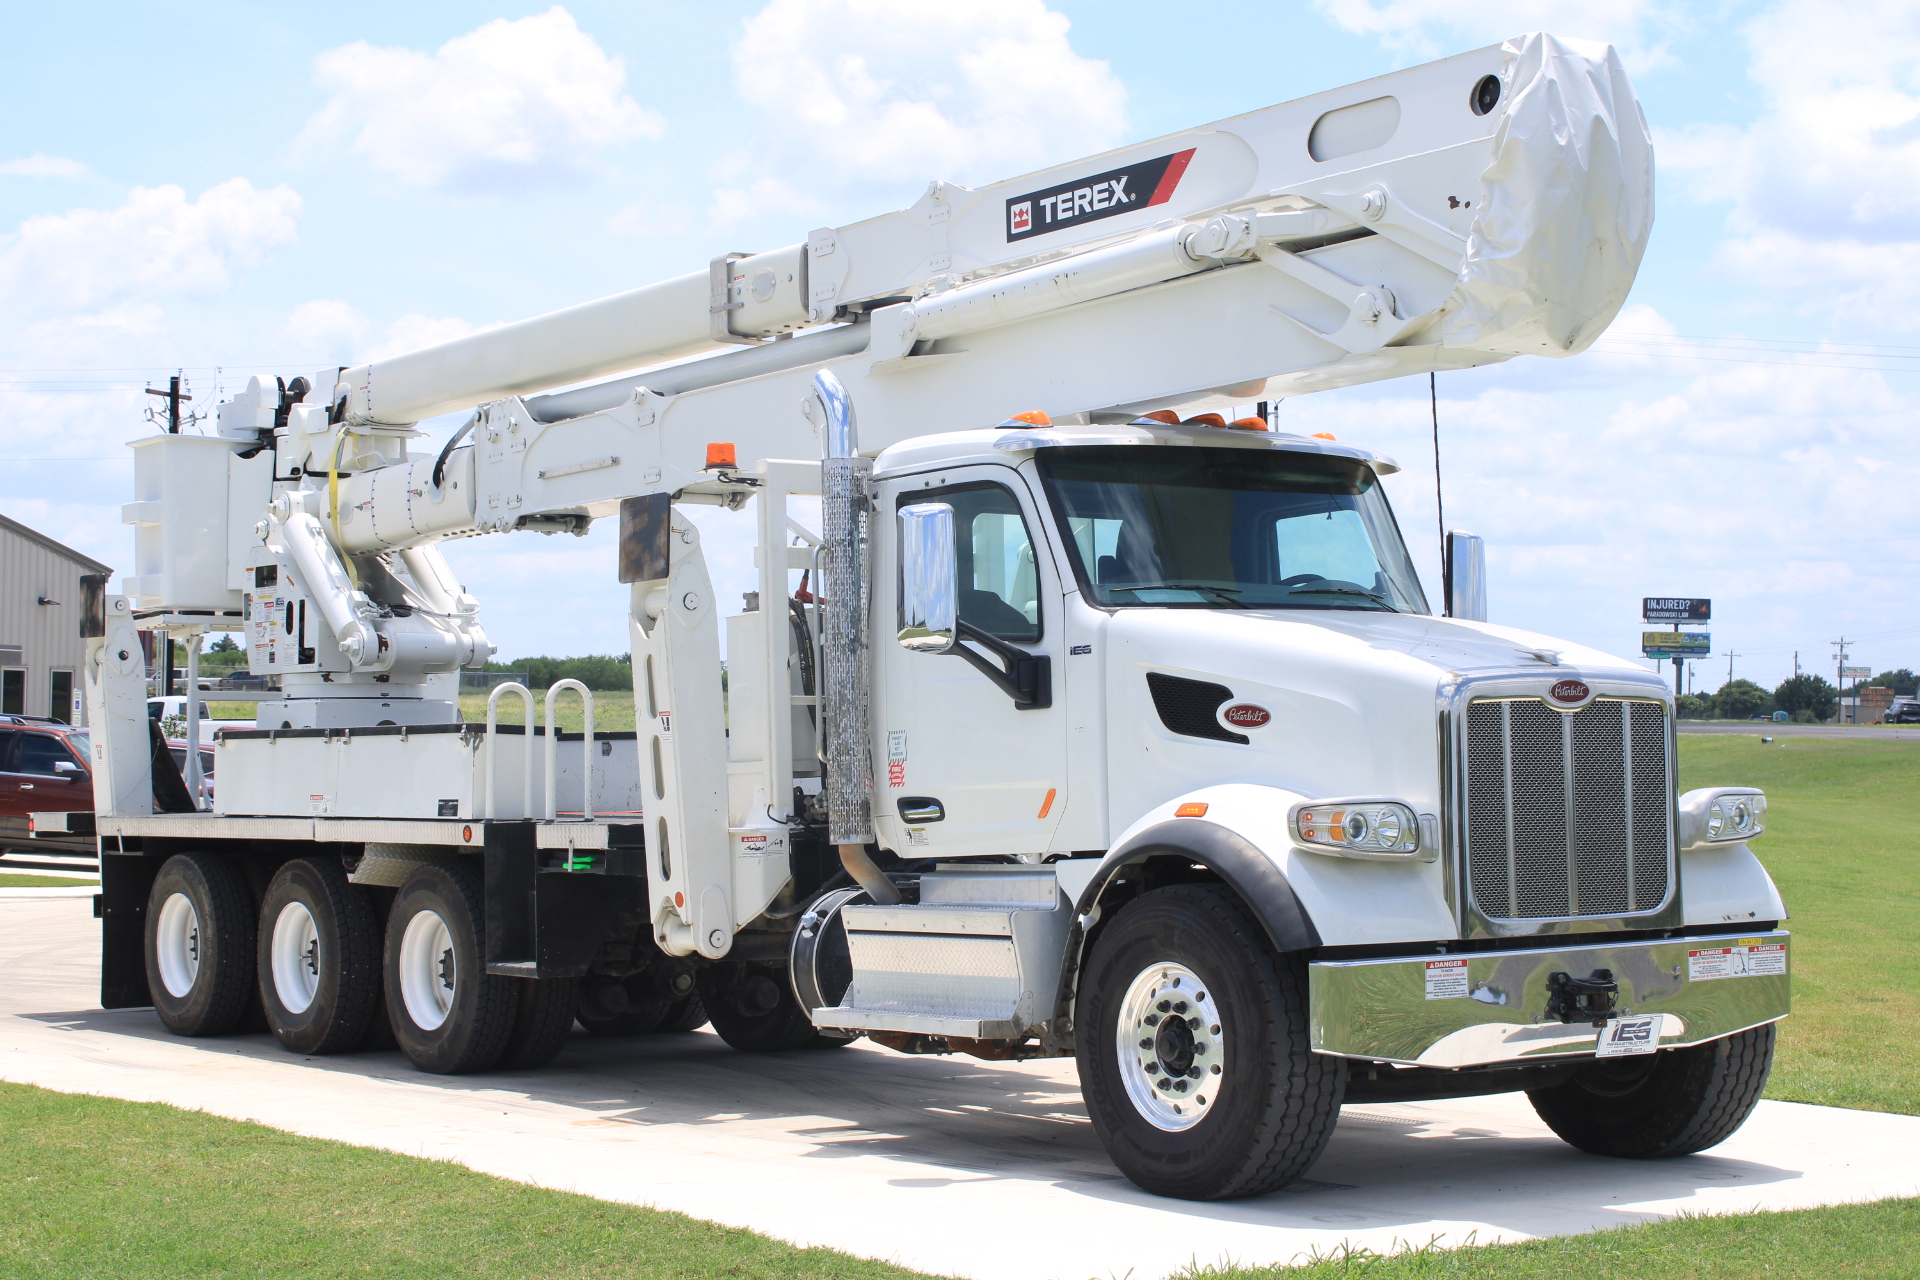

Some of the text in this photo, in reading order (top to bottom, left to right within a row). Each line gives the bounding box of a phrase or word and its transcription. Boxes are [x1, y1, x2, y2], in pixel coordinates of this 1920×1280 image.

[1040, 175, 1129, 224] TEREX
[1647, 599, 1690, 610] INJURED?
[1555, 684, 1587, 697] Peterbilt
[1229, 707, 1266, 722] Peterbilt
[1086, 993, 1121, 1135] BFGoodrich
